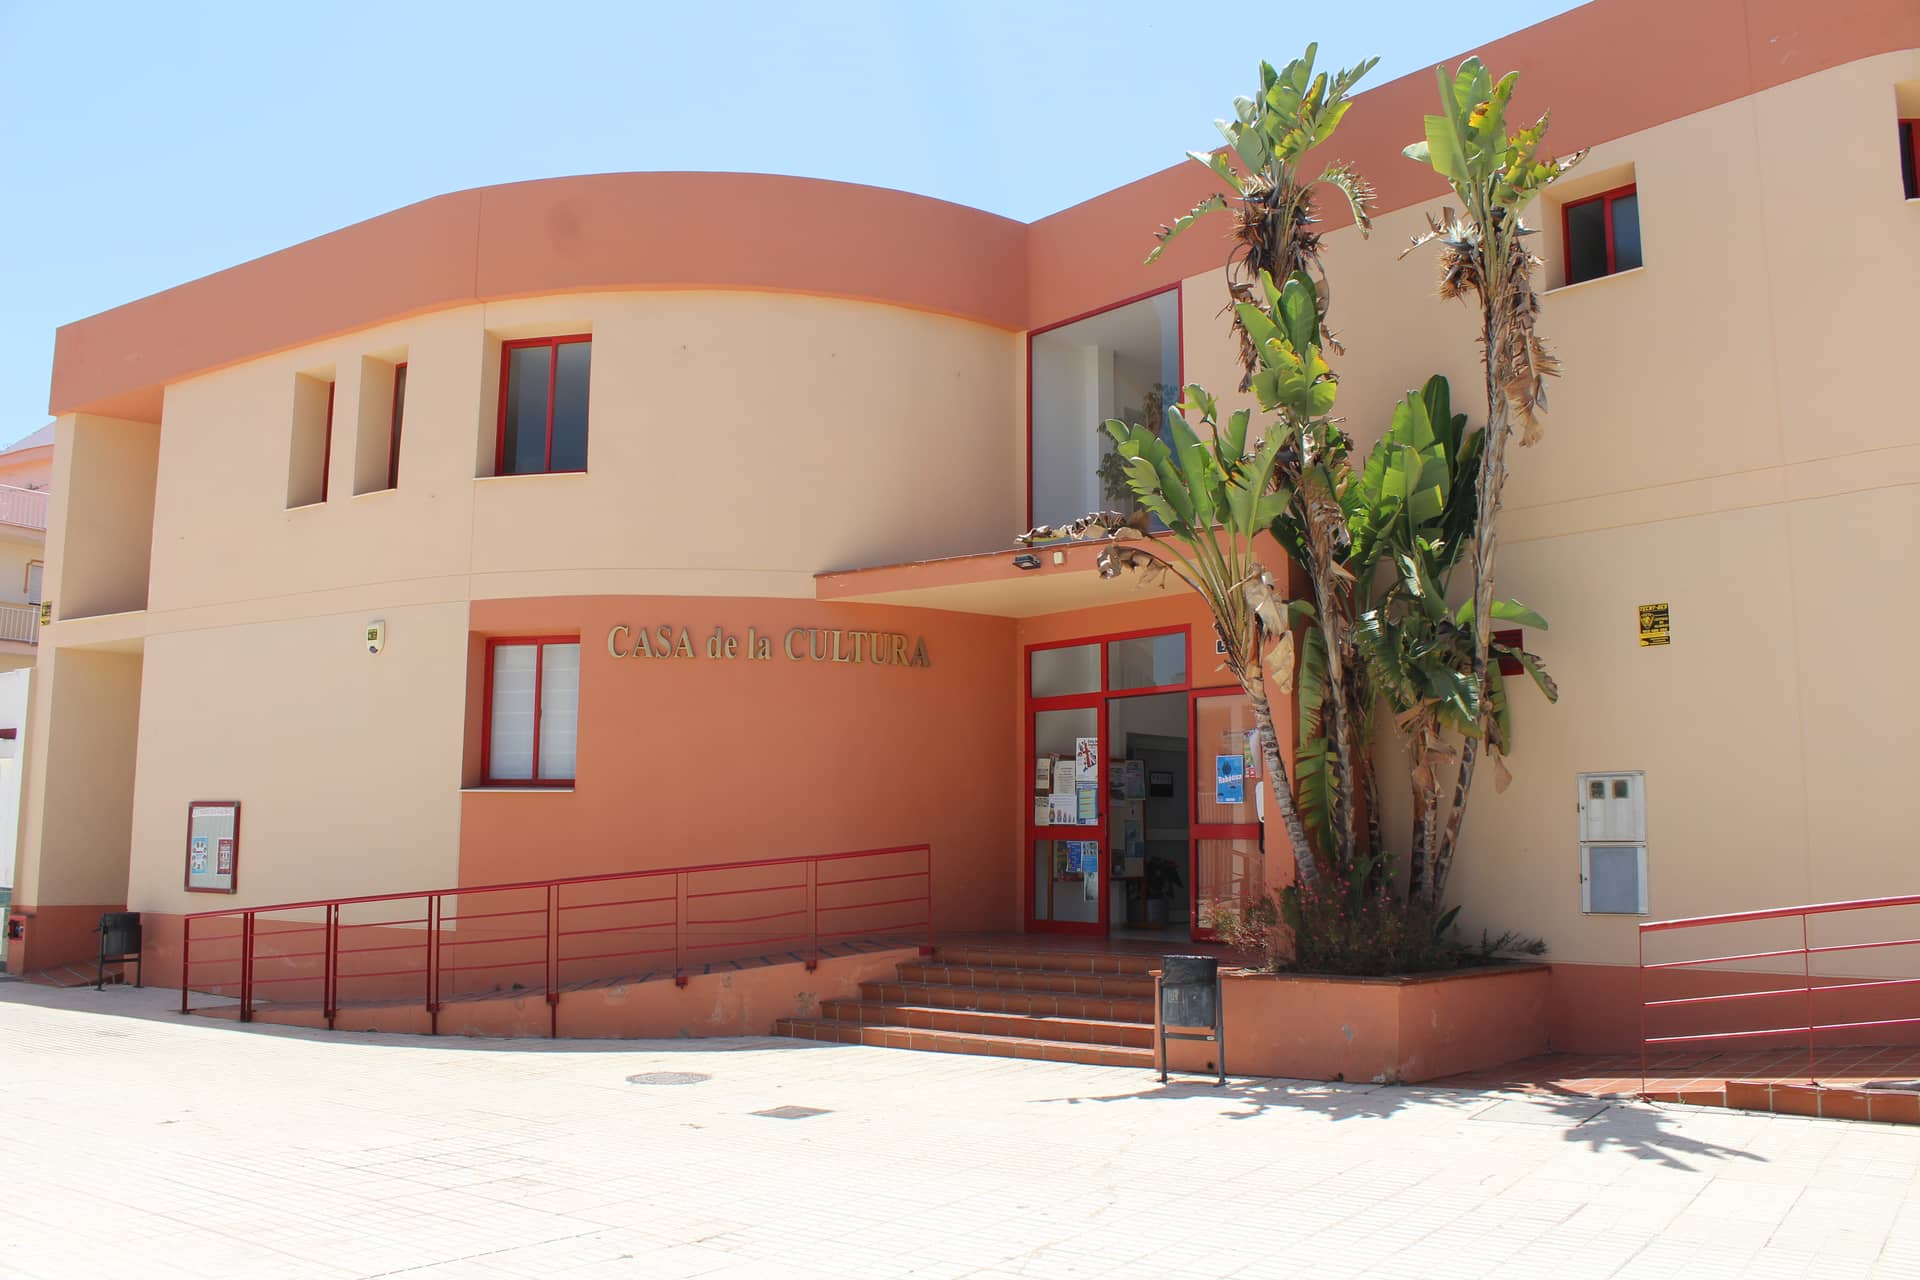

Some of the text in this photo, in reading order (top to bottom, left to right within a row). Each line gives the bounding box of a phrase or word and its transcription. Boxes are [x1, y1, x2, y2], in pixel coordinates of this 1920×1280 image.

[607, 625, 931, 667] CASA de la CULTURA
